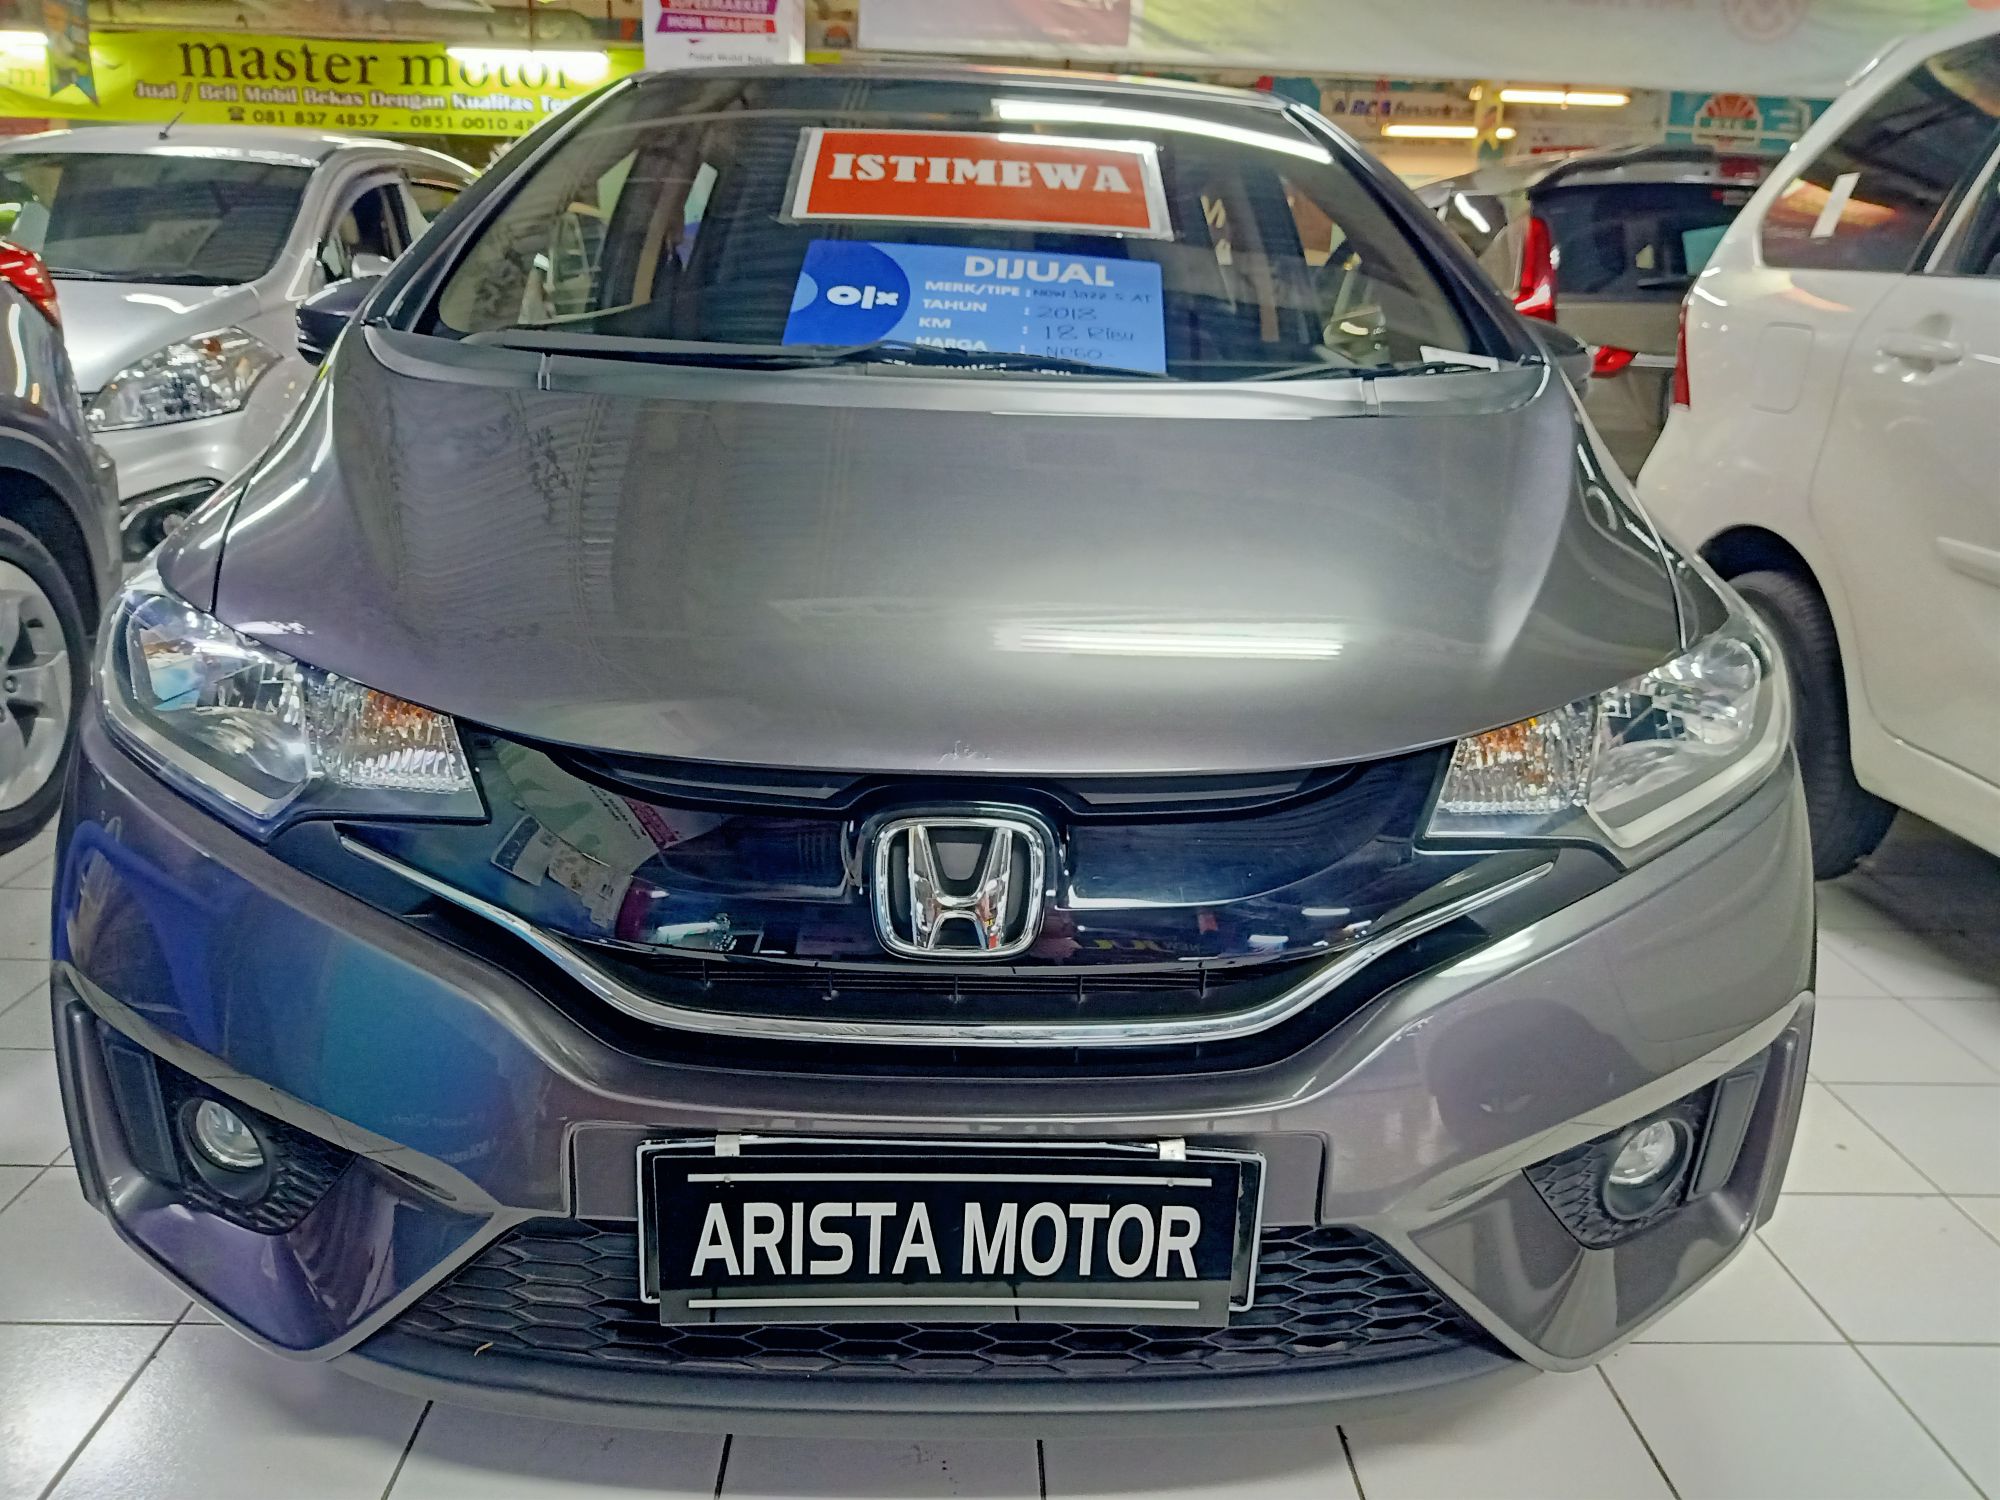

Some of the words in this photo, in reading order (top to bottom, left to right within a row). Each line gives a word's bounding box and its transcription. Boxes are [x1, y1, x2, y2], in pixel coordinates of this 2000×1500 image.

[178, 42, 378, 85] master
[135, 81, 177, 99] Jual
[199, 83, 238, 102] Beli
[244, 85, 299, 104] Mobil
[303, 87, 364, 107] Bekas
[369, 90, 445, 111] Dengan
[253, 110, 286, 124] 081
[294, 111, 326, 126] 837
[461, 117, 509, 131] 0010
[828, 152, 1132, 194] ISTIMEWA
[964, 255, 1114, 288] DIJUAL
[924, 280, 1021, 297] MERK/TIPE
[922, 299, 988, 313] TAHUN
[918, 316, 952, 330] KM
[690, 1201, 940, 1276] ARISTA
[961, 1201, 1201, 1279] MOTOR
